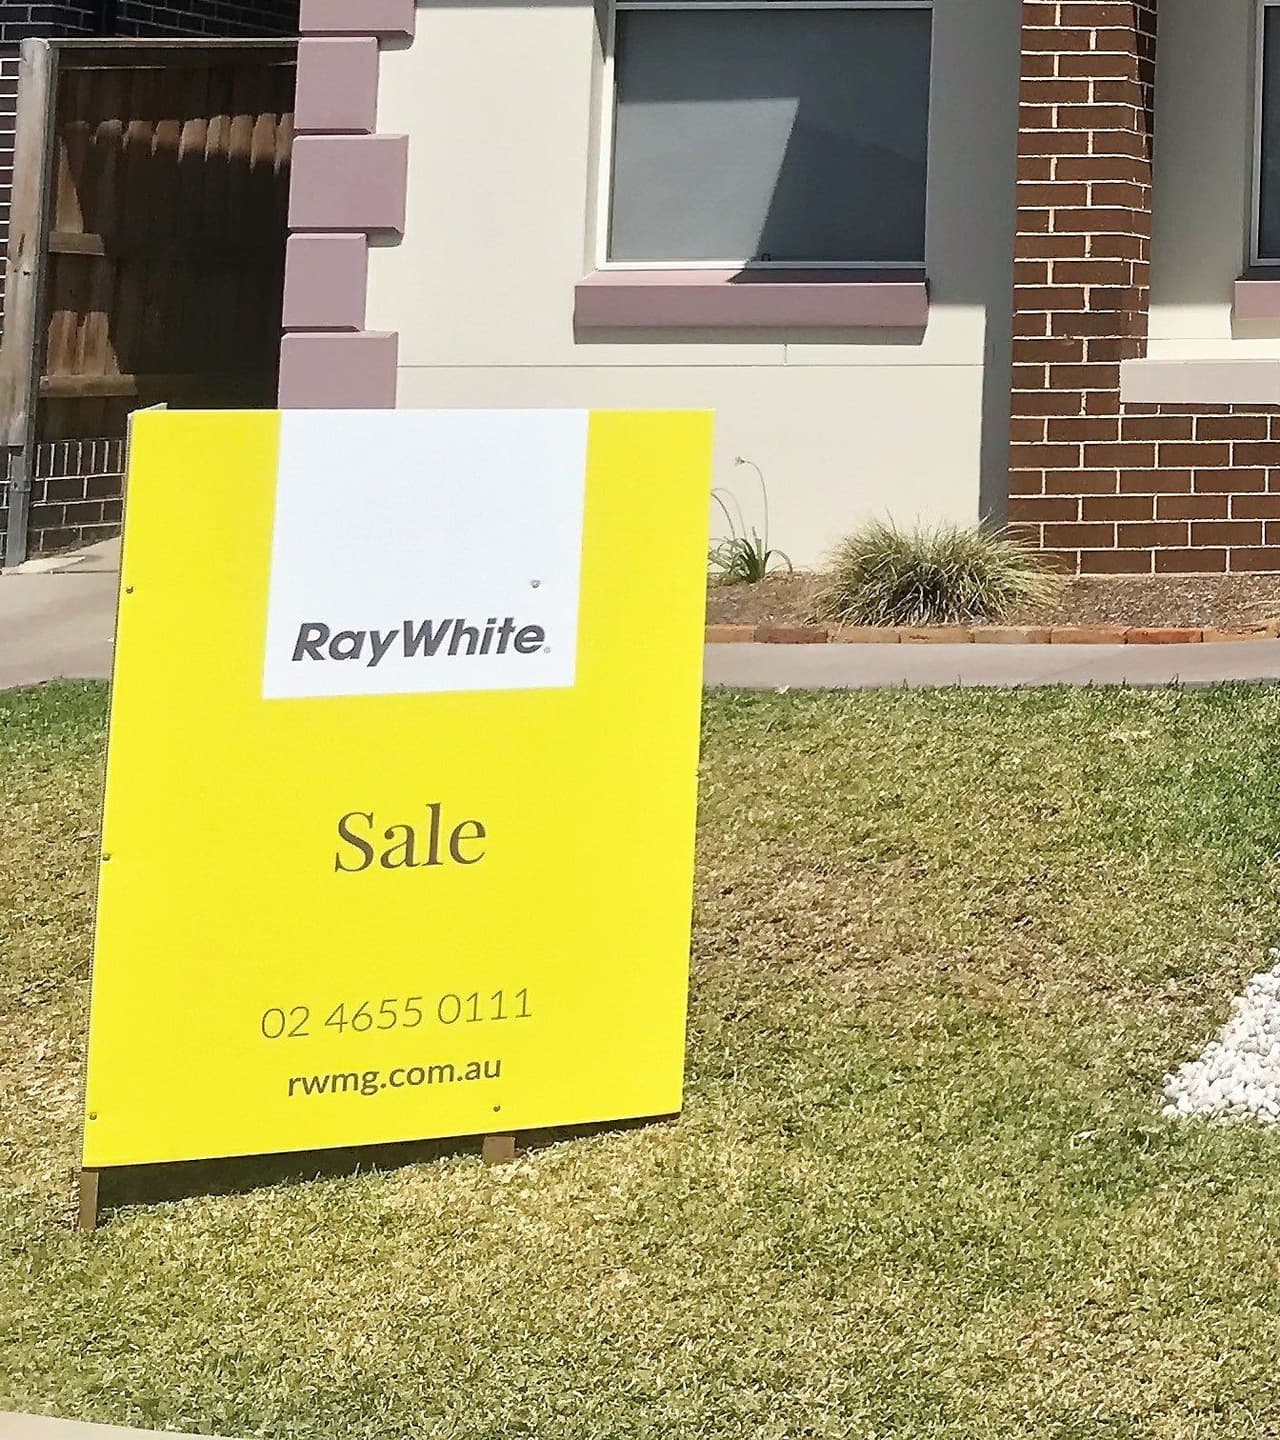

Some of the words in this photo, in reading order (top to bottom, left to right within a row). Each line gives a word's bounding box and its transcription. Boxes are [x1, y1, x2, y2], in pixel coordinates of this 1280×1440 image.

[335, 802, 486, 872] Sale
[261, 1006, 309, 1039] 02
[324, 997, 423, 1033] 4655
[437, 988, 532, 1024] 0111
[288, 1060, 501, 1096] rwmg.com.au
